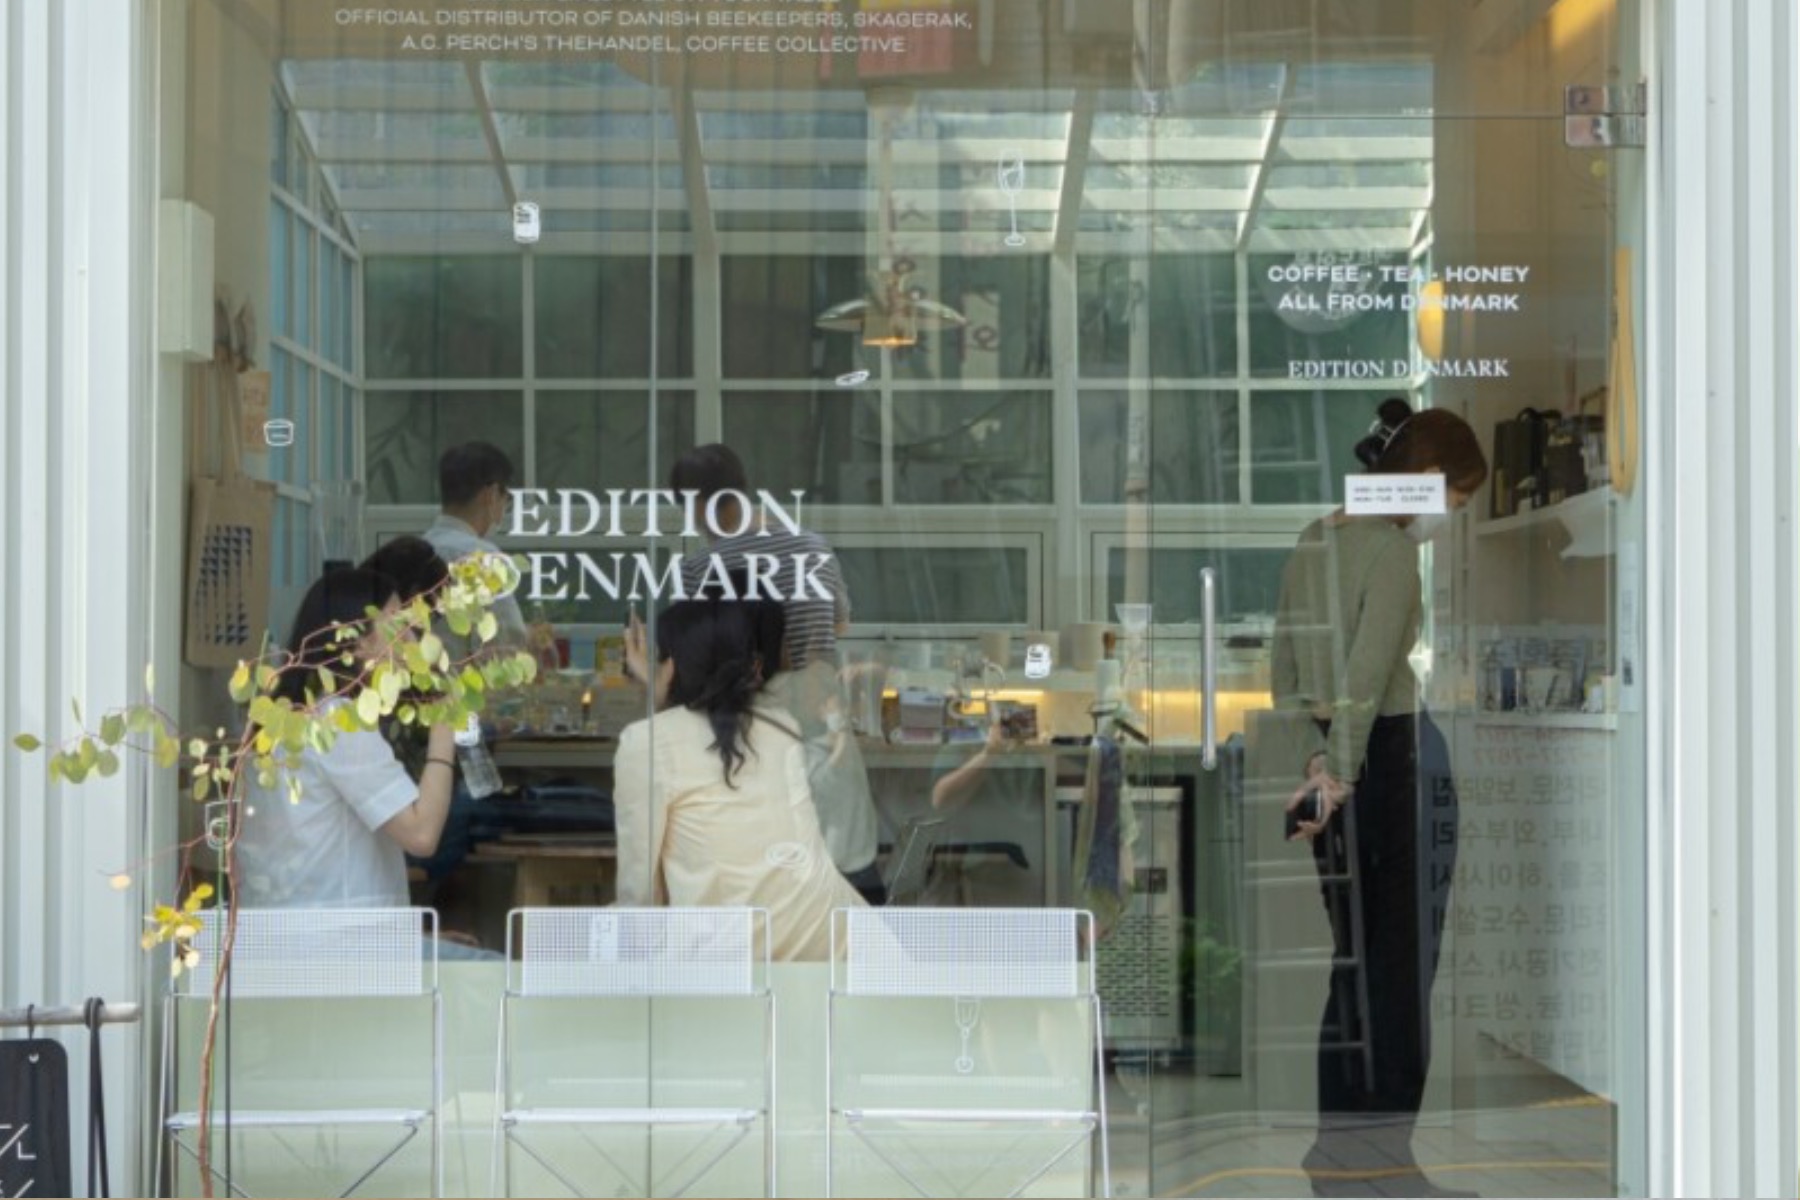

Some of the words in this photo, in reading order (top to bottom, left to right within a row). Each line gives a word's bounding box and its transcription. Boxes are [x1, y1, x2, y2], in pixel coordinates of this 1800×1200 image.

[334, 8, 430, 25] OFFICIAL
[436, 9, 579, 26] DISTRIBUTOR
[583, 10, 613, 26] OF
[618, 10, 700, 27] DANISH
[706, 11, 848, 29] BEEKEEPERS,
[853, 12, 973, 30] SKAGERAK,
[446, 34, 538, 51] PERCH'S
[686, 36, 770, 52] COFFEE
[775, 36, 907, 53] COLLECTIVE
[1268, 265, 1358, 283] COFFEE
[1379, 265, 1424, 283] TEA
[1445, 265, 1529, 283] HONEY
[1278, 293, 1321, 311] ALL
[1327, 293, 1393, 311] FROM
[1400, 293, 1519, 311] DNMARK
[1287, 359, 1385, 378] EDITION
[1392, 359, 1510, 378] DNMARK
[506, 487, 807, 537] EDITION
